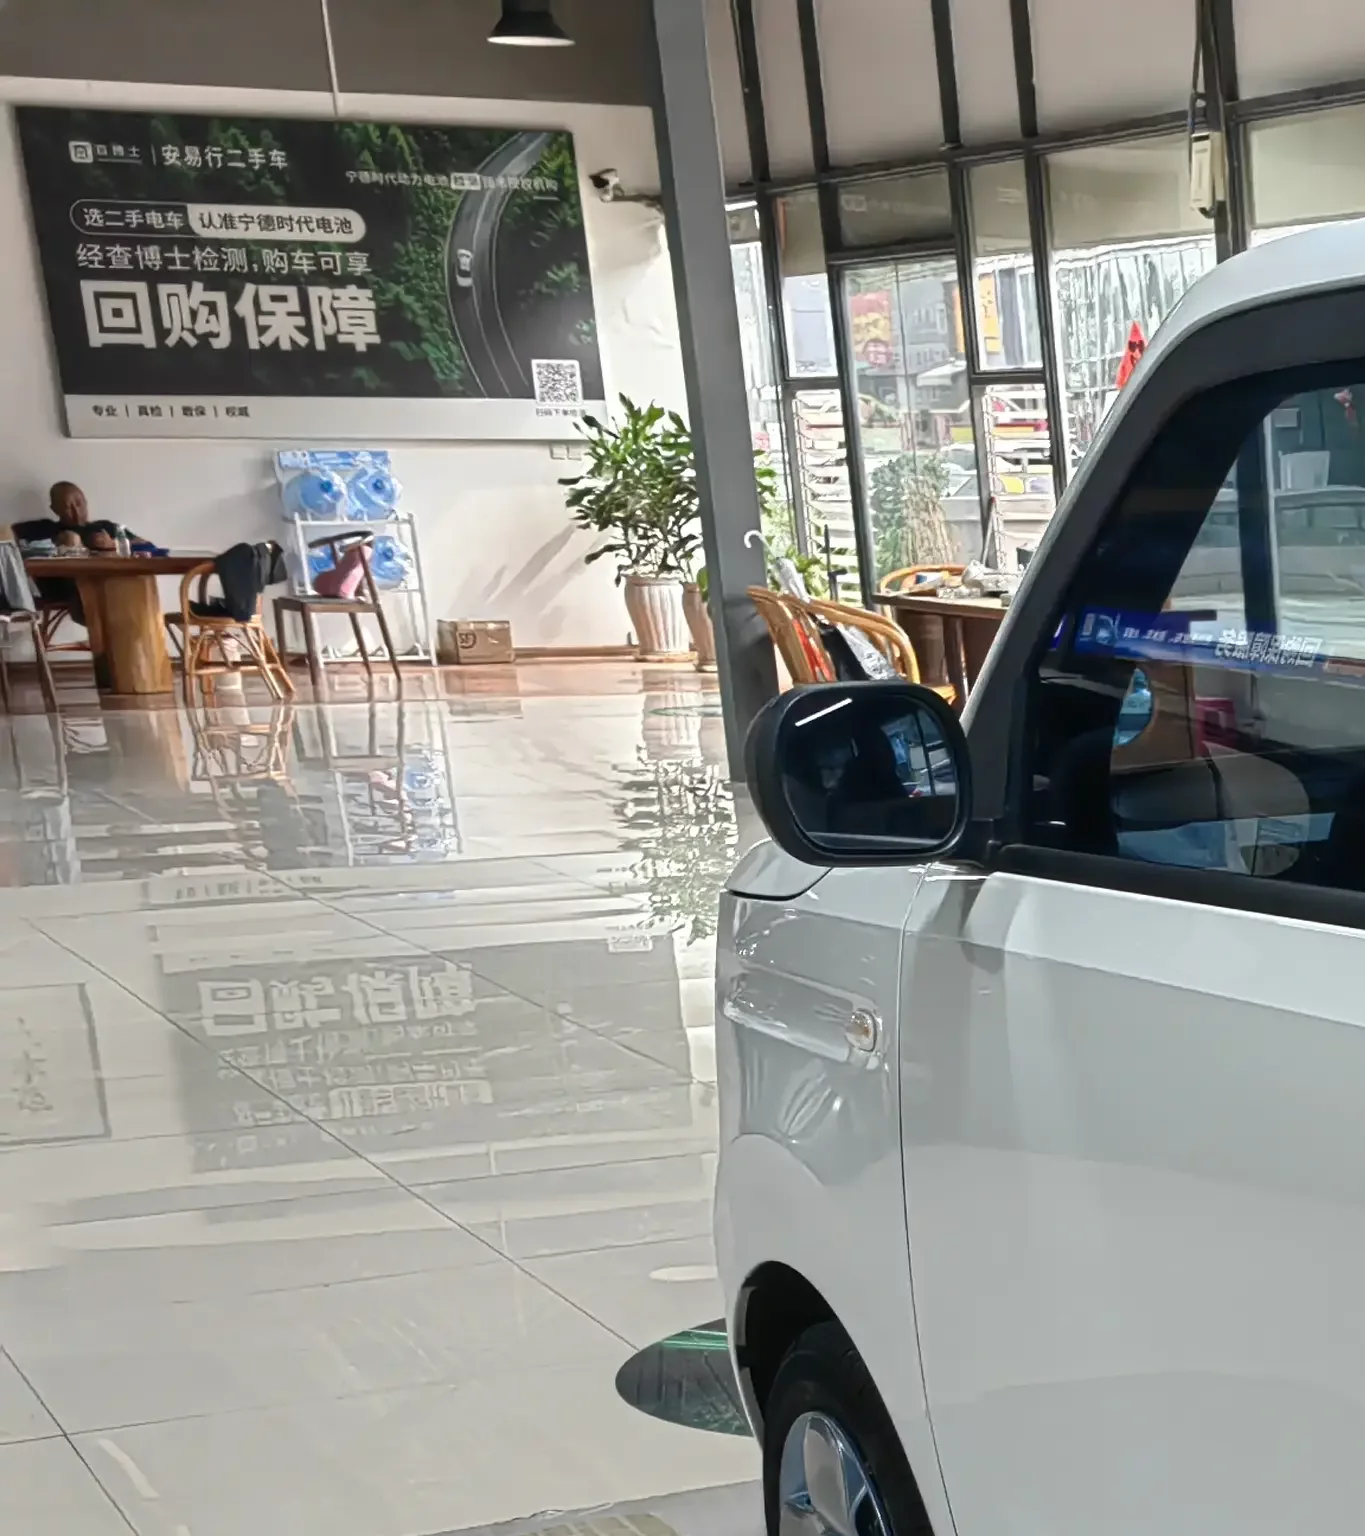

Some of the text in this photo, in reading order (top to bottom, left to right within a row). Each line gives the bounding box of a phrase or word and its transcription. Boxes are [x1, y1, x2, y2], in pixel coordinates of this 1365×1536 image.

[161, 144, 289, 170] 安易行二手车
[83, 208, 354, 235] 选二手电车 认准宁德时代电池
[81, 281, 382, 353] 回购保障
